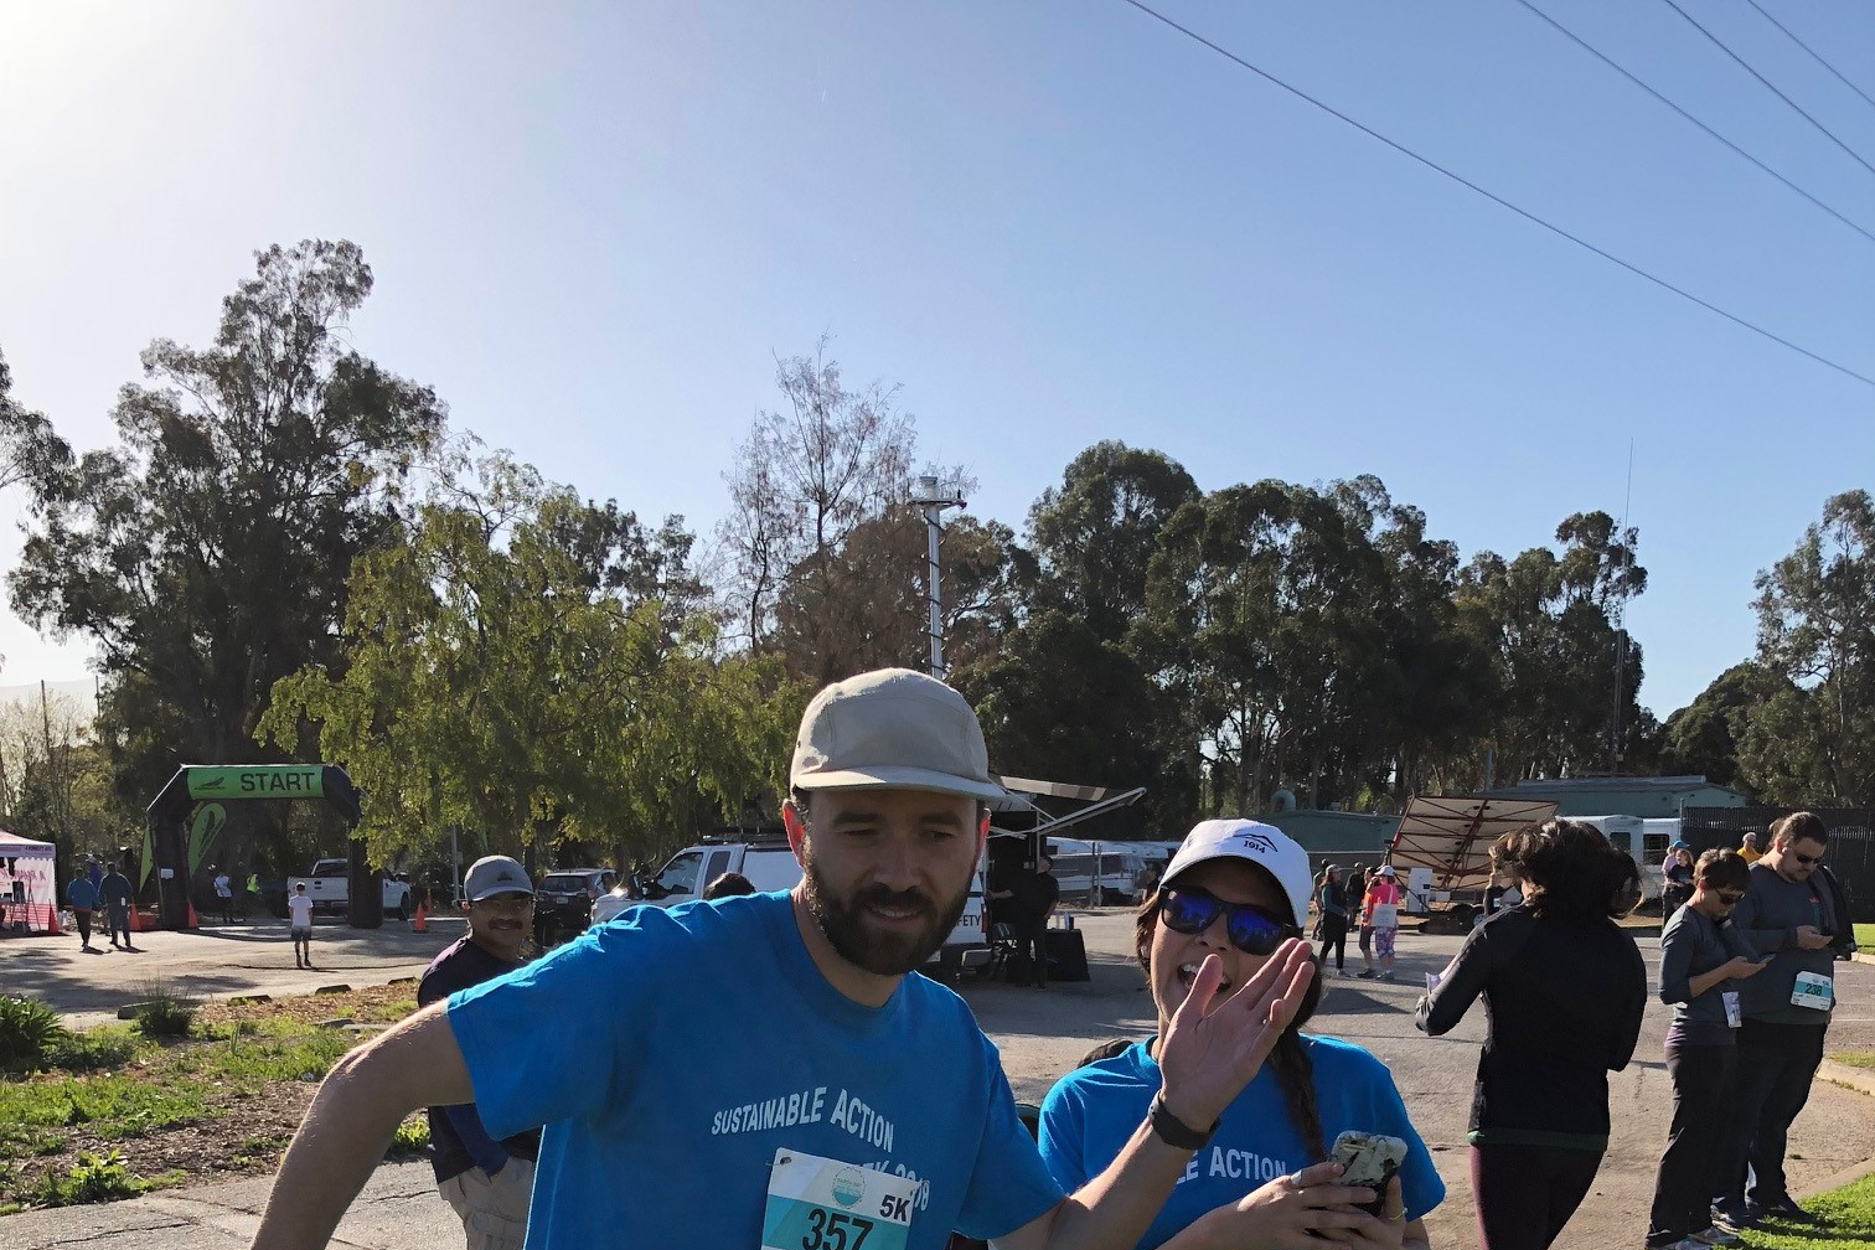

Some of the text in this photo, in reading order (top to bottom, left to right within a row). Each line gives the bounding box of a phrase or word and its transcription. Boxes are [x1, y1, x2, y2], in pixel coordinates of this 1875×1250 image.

[240, 772, 315, 792] START
[1805, 983, 1823, 996] 238
[711, 1086, 894, 1153] SUSTAINABLE ACTION
[1208, 1145, 1287, 1182] ACTION
[880, 1194, 910, 1222] 5K
